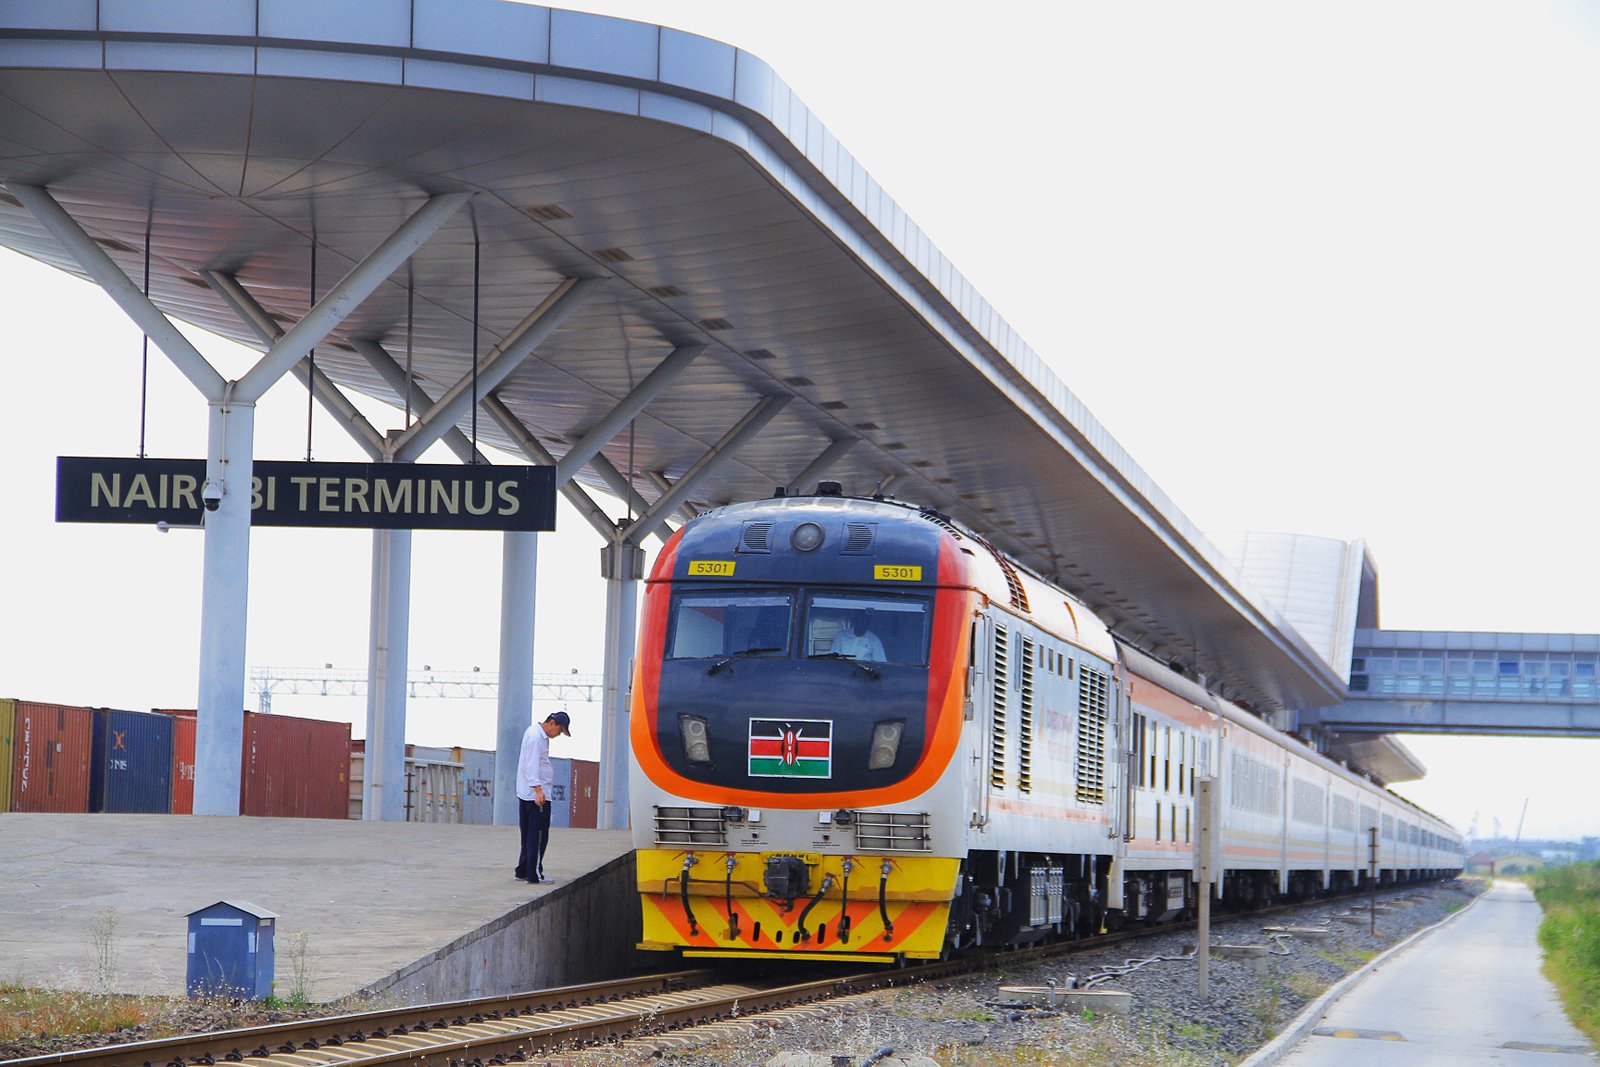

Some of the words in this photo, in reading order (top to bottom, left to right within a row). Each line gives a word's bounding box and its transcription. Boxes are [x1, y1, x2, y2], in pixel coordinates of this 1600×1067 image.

[90, 472, 276, 511] NAIRBI
[290, 476, 520, 516] TERMINUS
[697, 563, 727, 573] 5301
[882, 567, 913, 578] 5301
